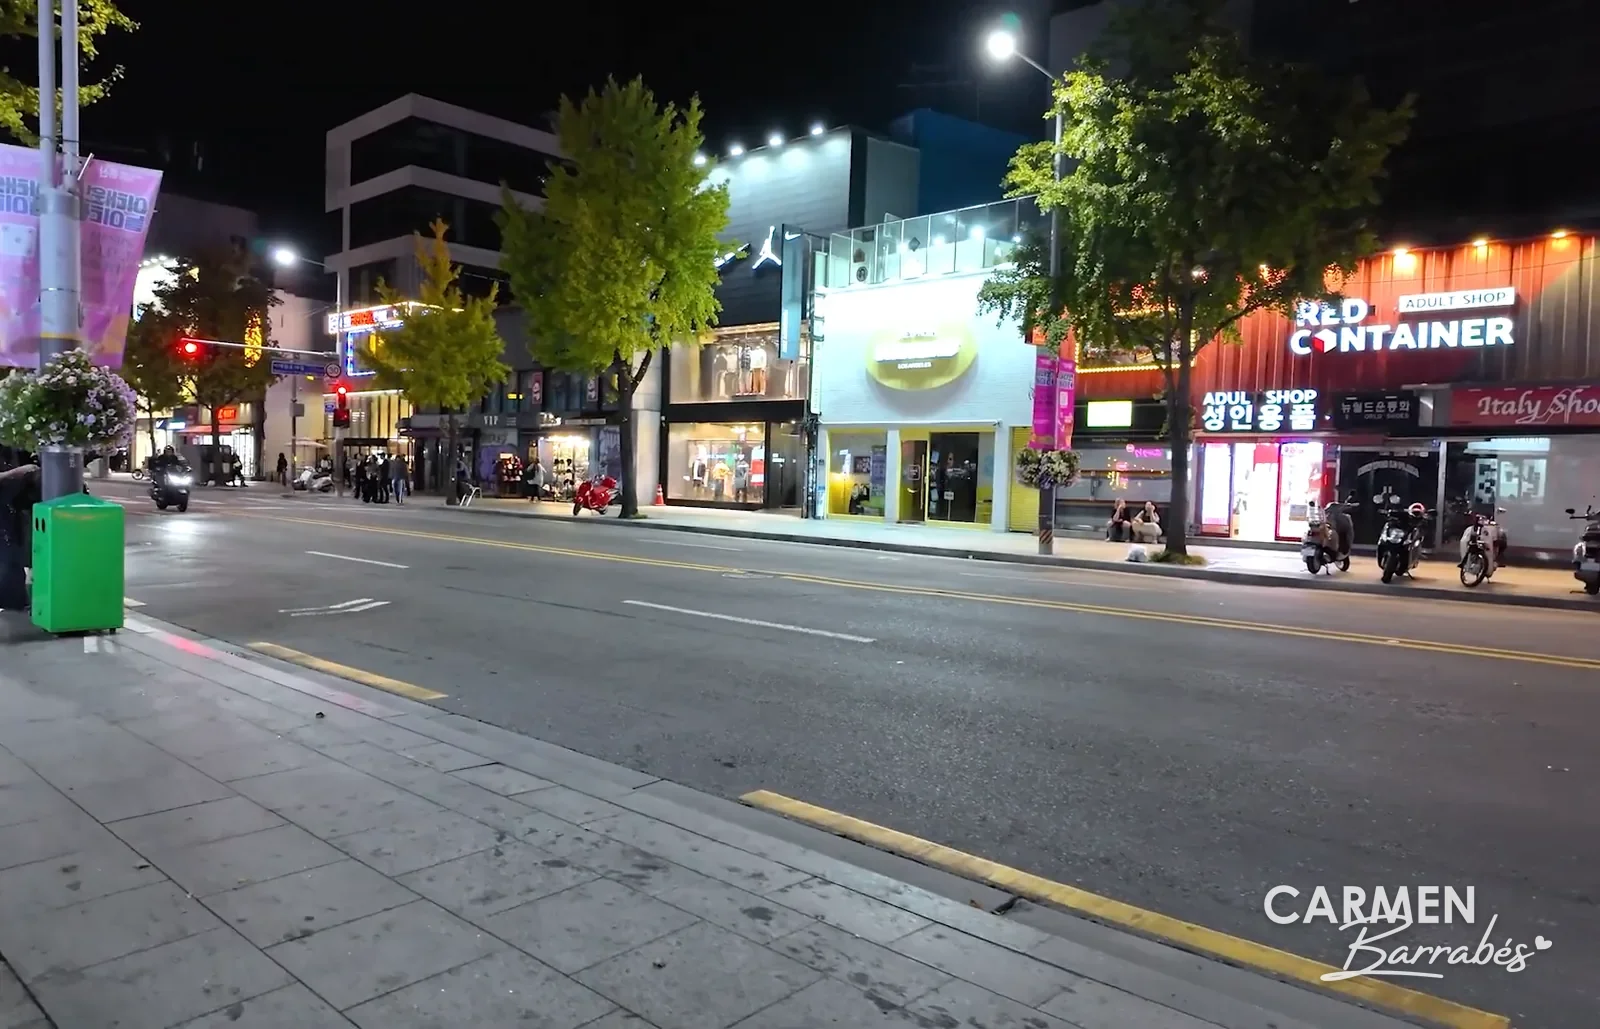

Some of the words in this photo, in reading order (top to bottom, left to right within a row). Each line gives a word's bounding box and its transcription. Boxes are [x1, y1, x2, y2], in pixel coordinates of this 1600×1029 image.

[1296, 298, 1368, 328] RED
[1405, 296, 1455, 309] ADULT
[1462, 291, 1507, 305] SHOP
[1265, 389, 1318, 405] SHOP
[1478, 390, 1541, 424] Italy
[1549, 388, 1600, 414] Sho
[1201, 404, 1317, 431] 성인용품
